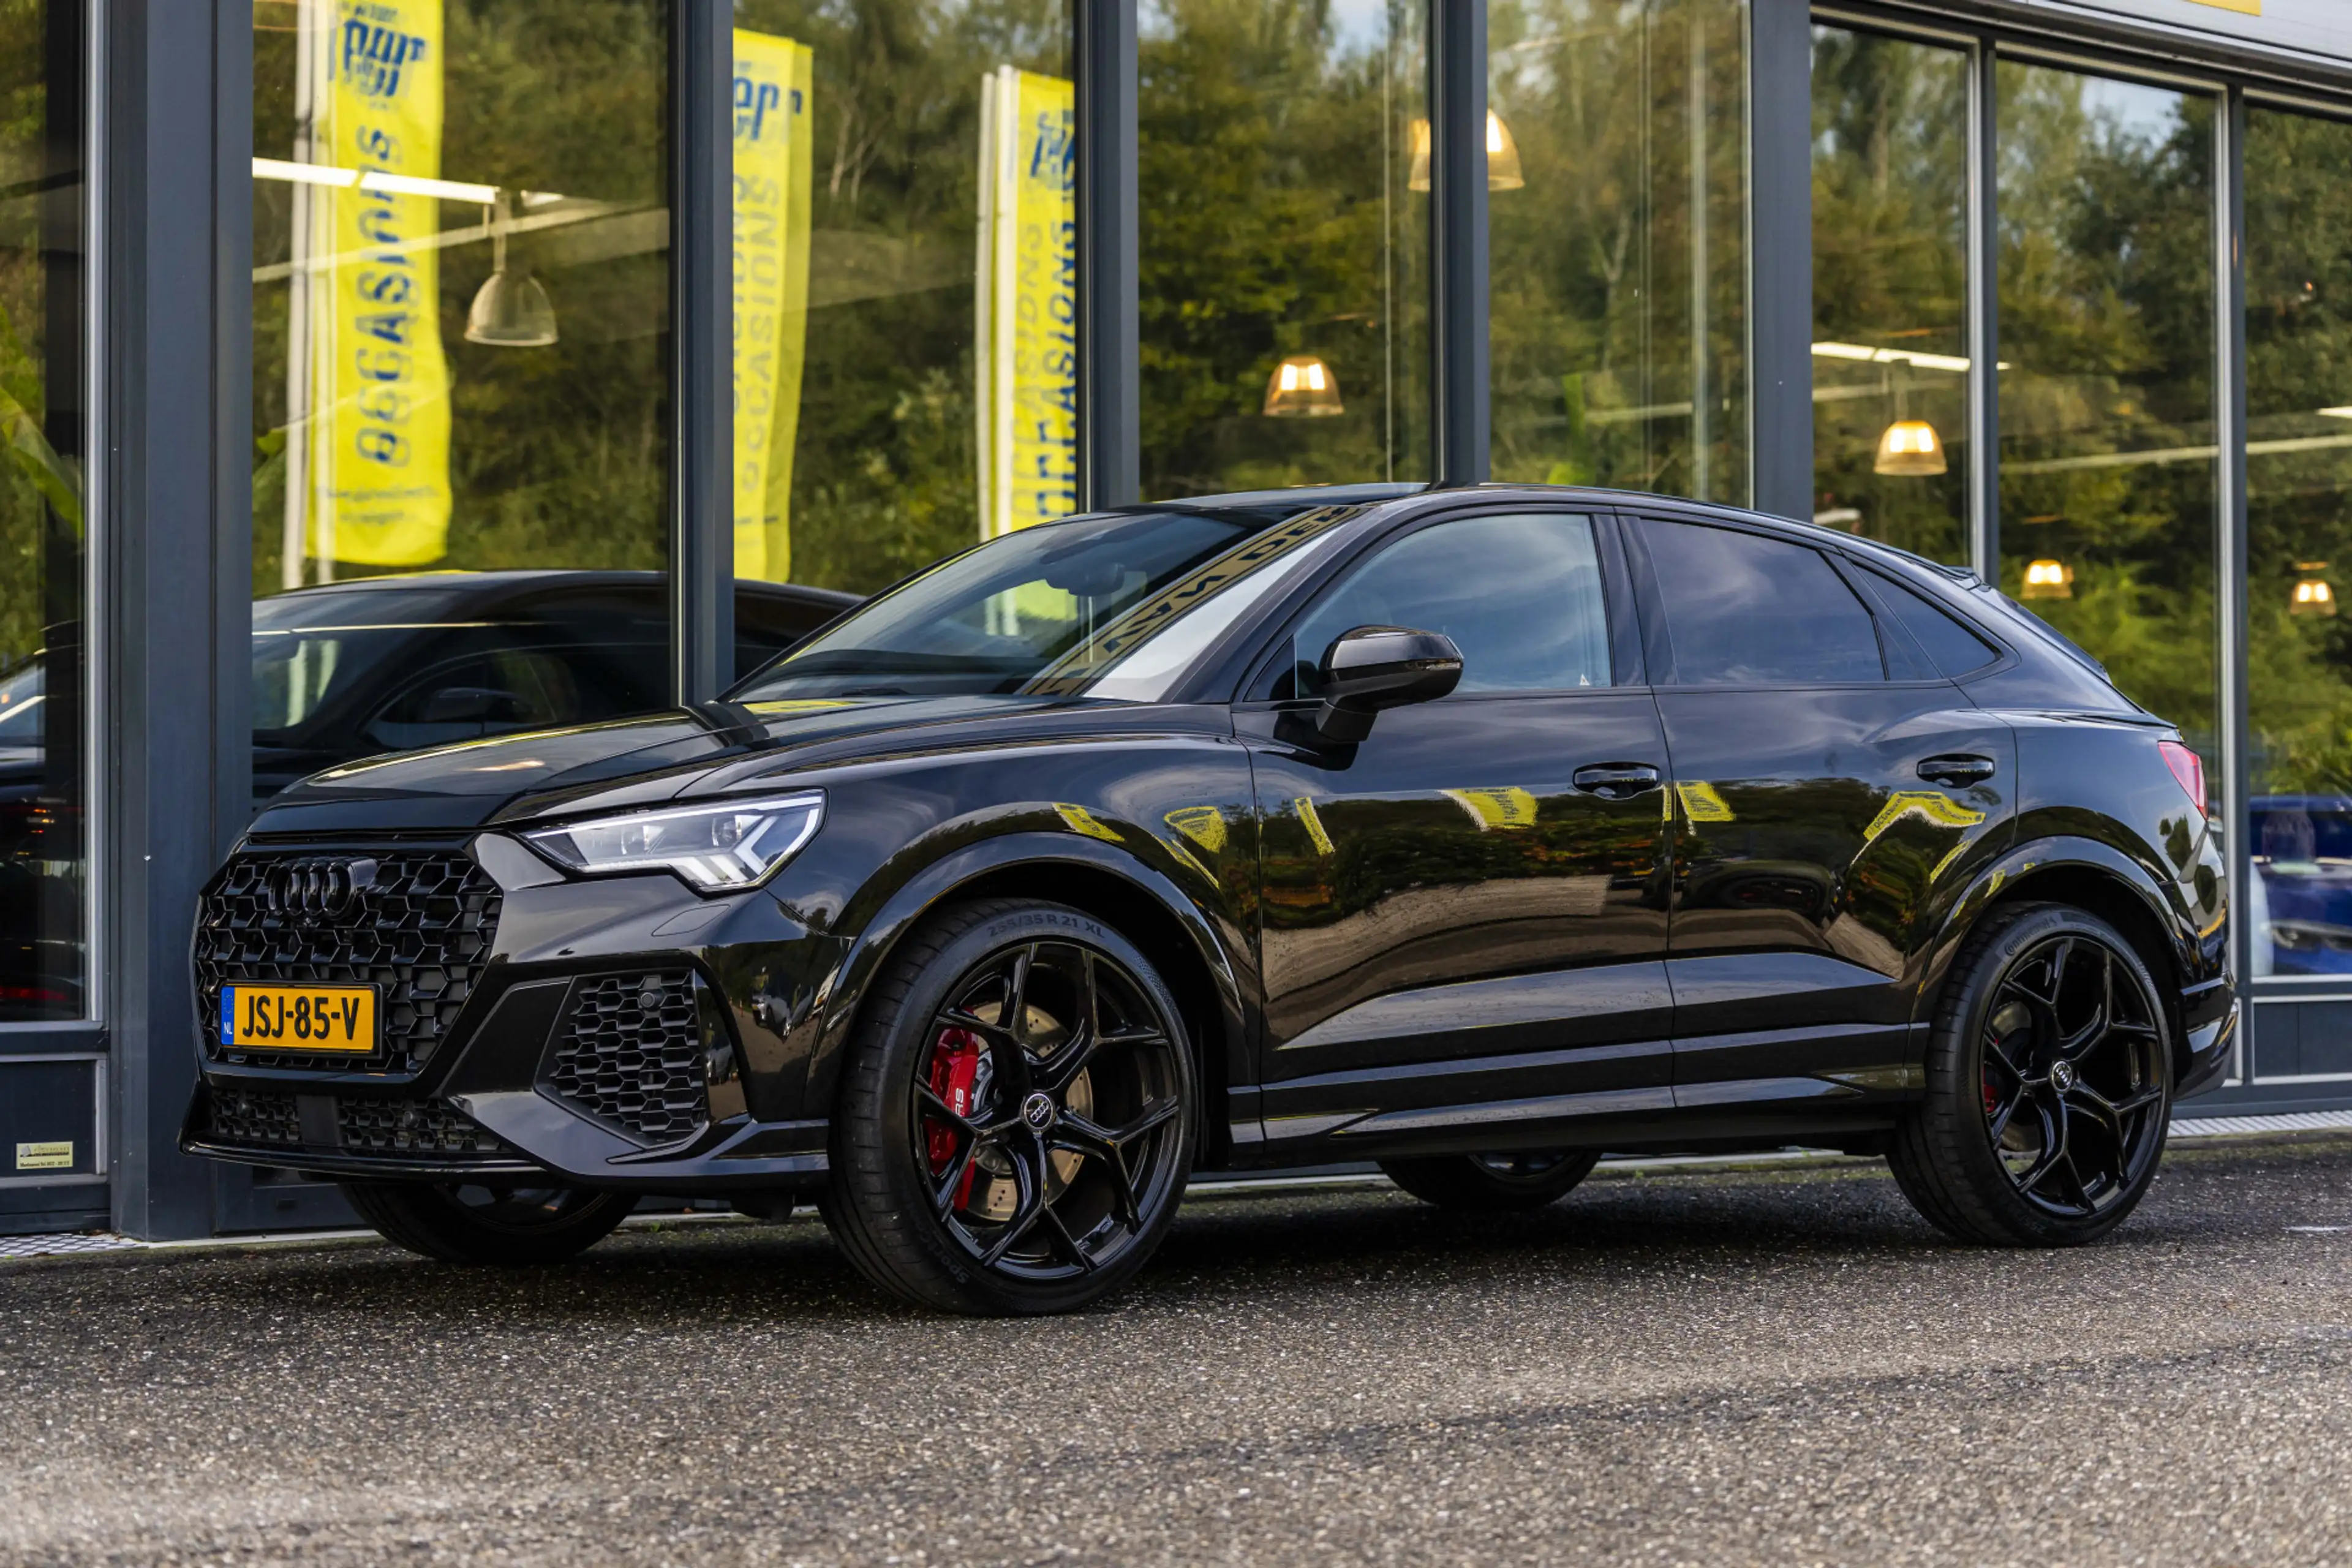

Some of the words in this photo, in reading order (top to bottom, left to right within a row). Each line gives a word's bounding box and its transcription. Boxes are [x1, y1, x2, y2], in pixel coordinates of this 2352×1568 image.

[1061, 915, 1079, 929] 21
[1085, 921, 1105, 938] XL
[224, 1021, 233, 1035] NL
[243, 995, 360, 1041] JSJ-85-V
